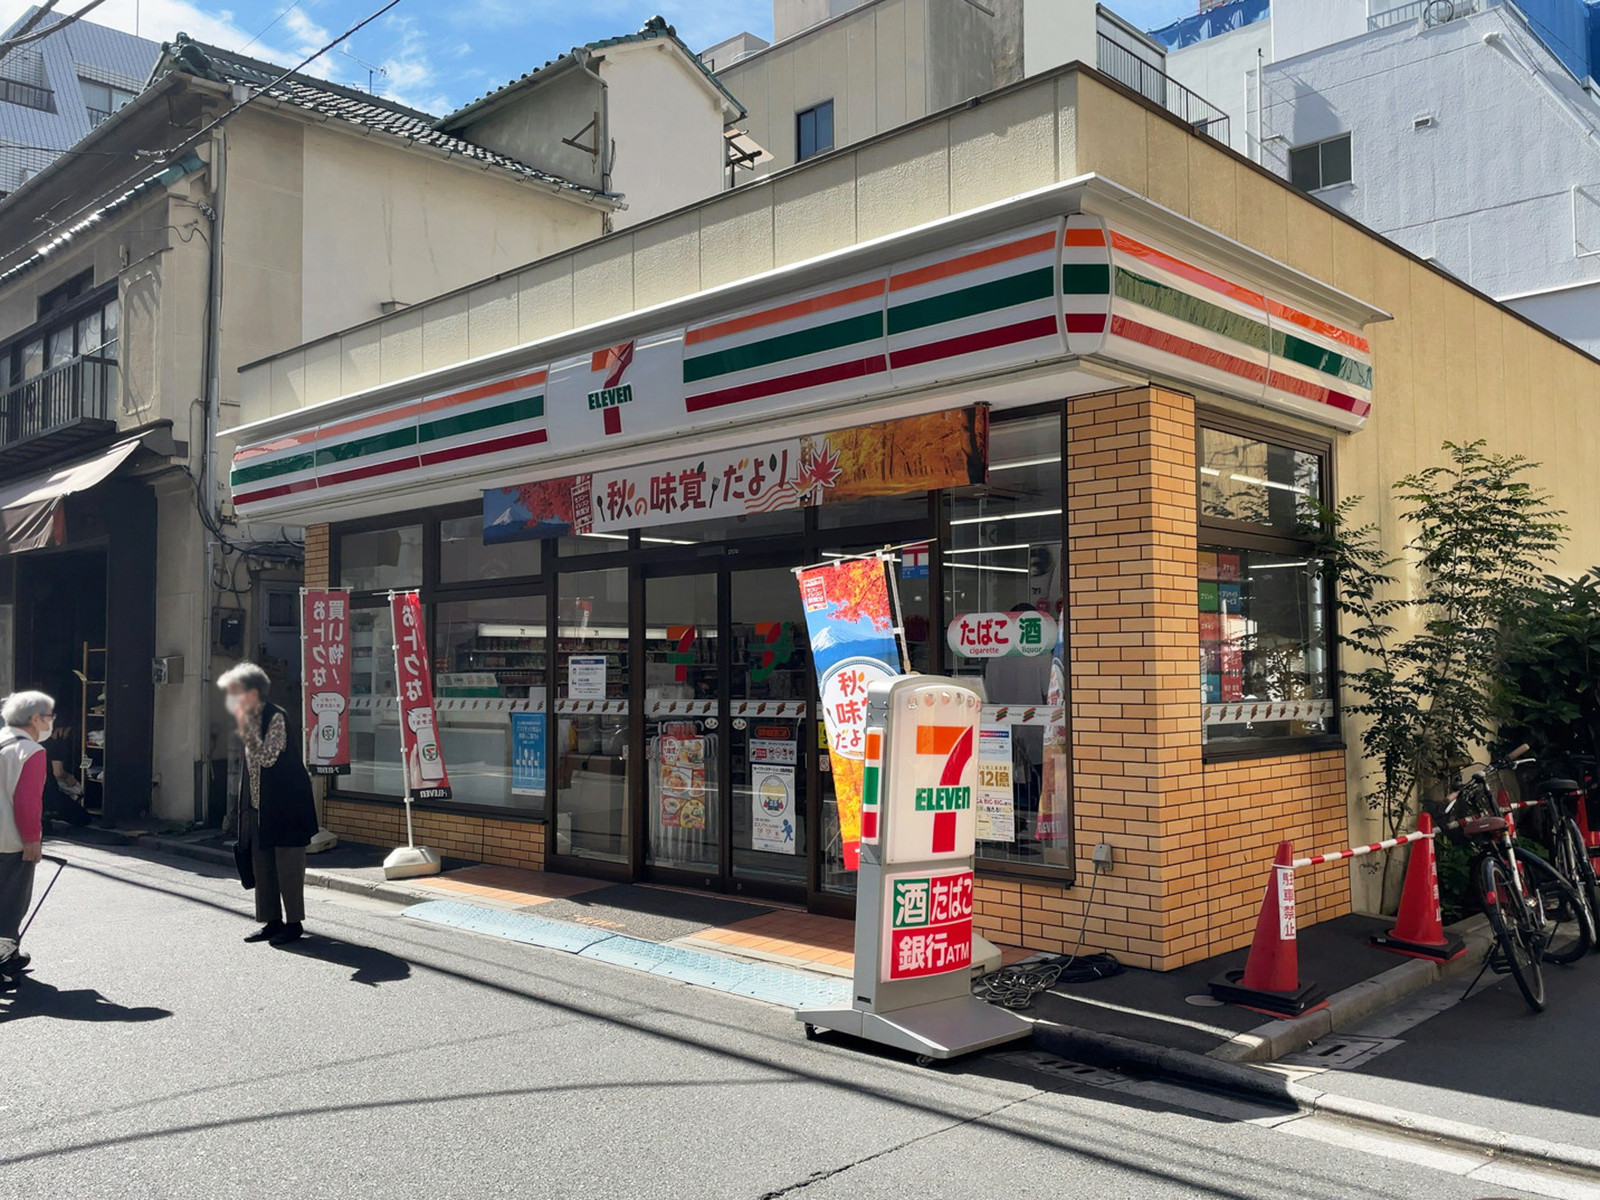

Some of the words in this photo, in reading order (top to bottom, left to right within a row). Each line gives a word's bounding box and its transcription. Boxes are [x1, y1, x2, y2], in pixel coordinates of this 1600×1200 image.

[607, 449, 788, 521] 秋の味覚だより
[960, 618, 1009, 646] たばこ
[1019, 617, 1042, 644] 酒
[969, 647, 999, 655] cigarette
[1022, 645, 1042, 654] liquor
[835, 697, 868, 725] 味
[835, 729, 862, 751] だよ
[916, 724, 973, 853] 7
[895, 882, 929, 926] 酒
[931, 877, 972, 922] たばこ
[1283, 872, 1295, 937] 駐車禁止
[898, 932, 970, 972] 銀行ATM
